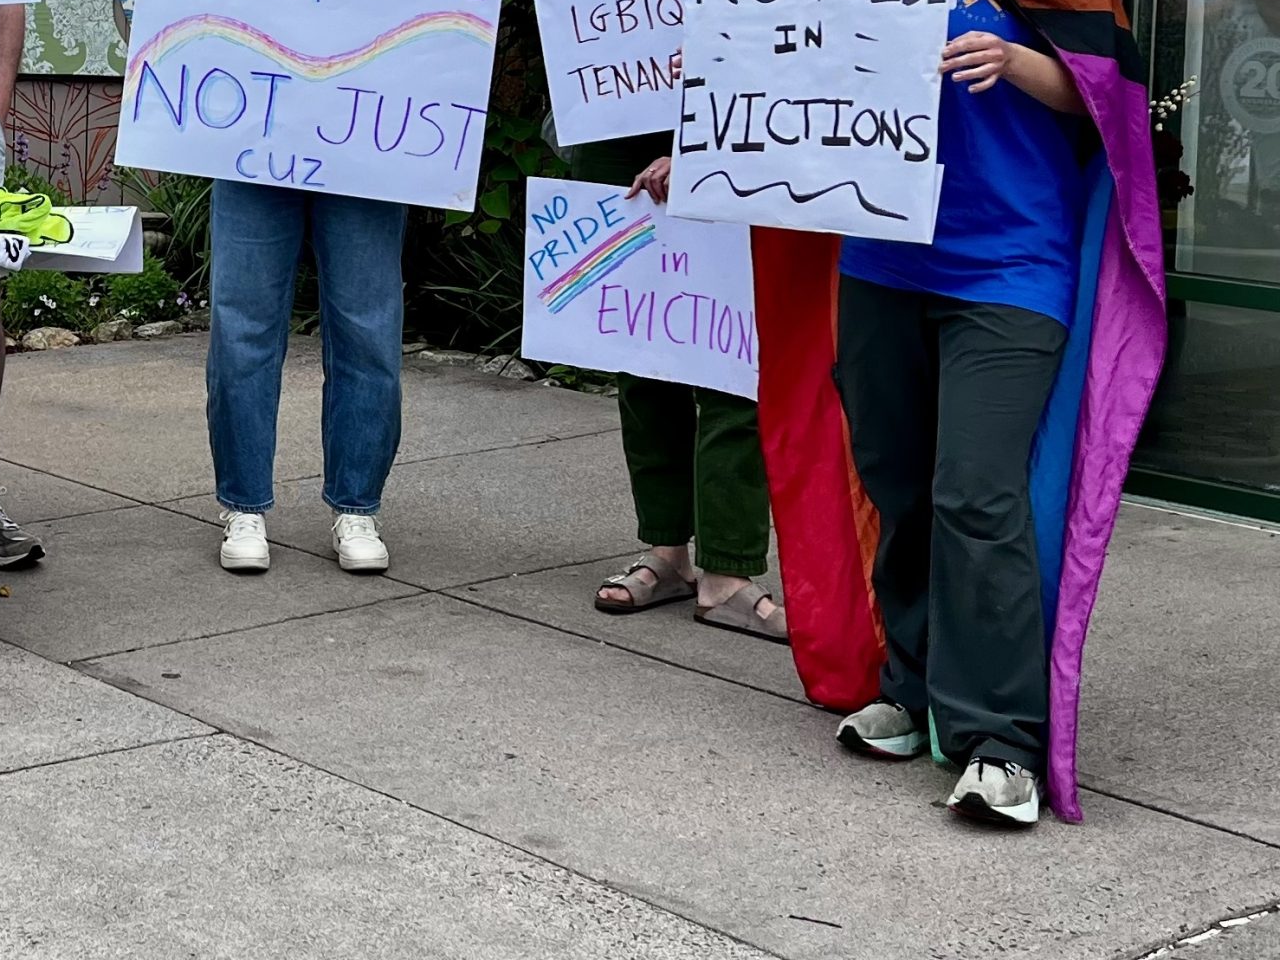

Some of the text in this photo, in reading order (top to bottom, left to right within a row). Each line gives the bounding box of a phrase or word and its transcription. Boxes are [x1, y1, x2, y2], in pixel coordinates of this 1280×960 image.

[774, 20, 822, 54] IN
[133, 60, 487, 171] NOT JUST
[568, 52, 682, 104] TENAN
[678, 76, 931, 162] EVICTIONS
[530, 194, 626, 281] PRIDE
[532, 195, 568, 235] NO
[598, 284, 753, 365] EVICTION
